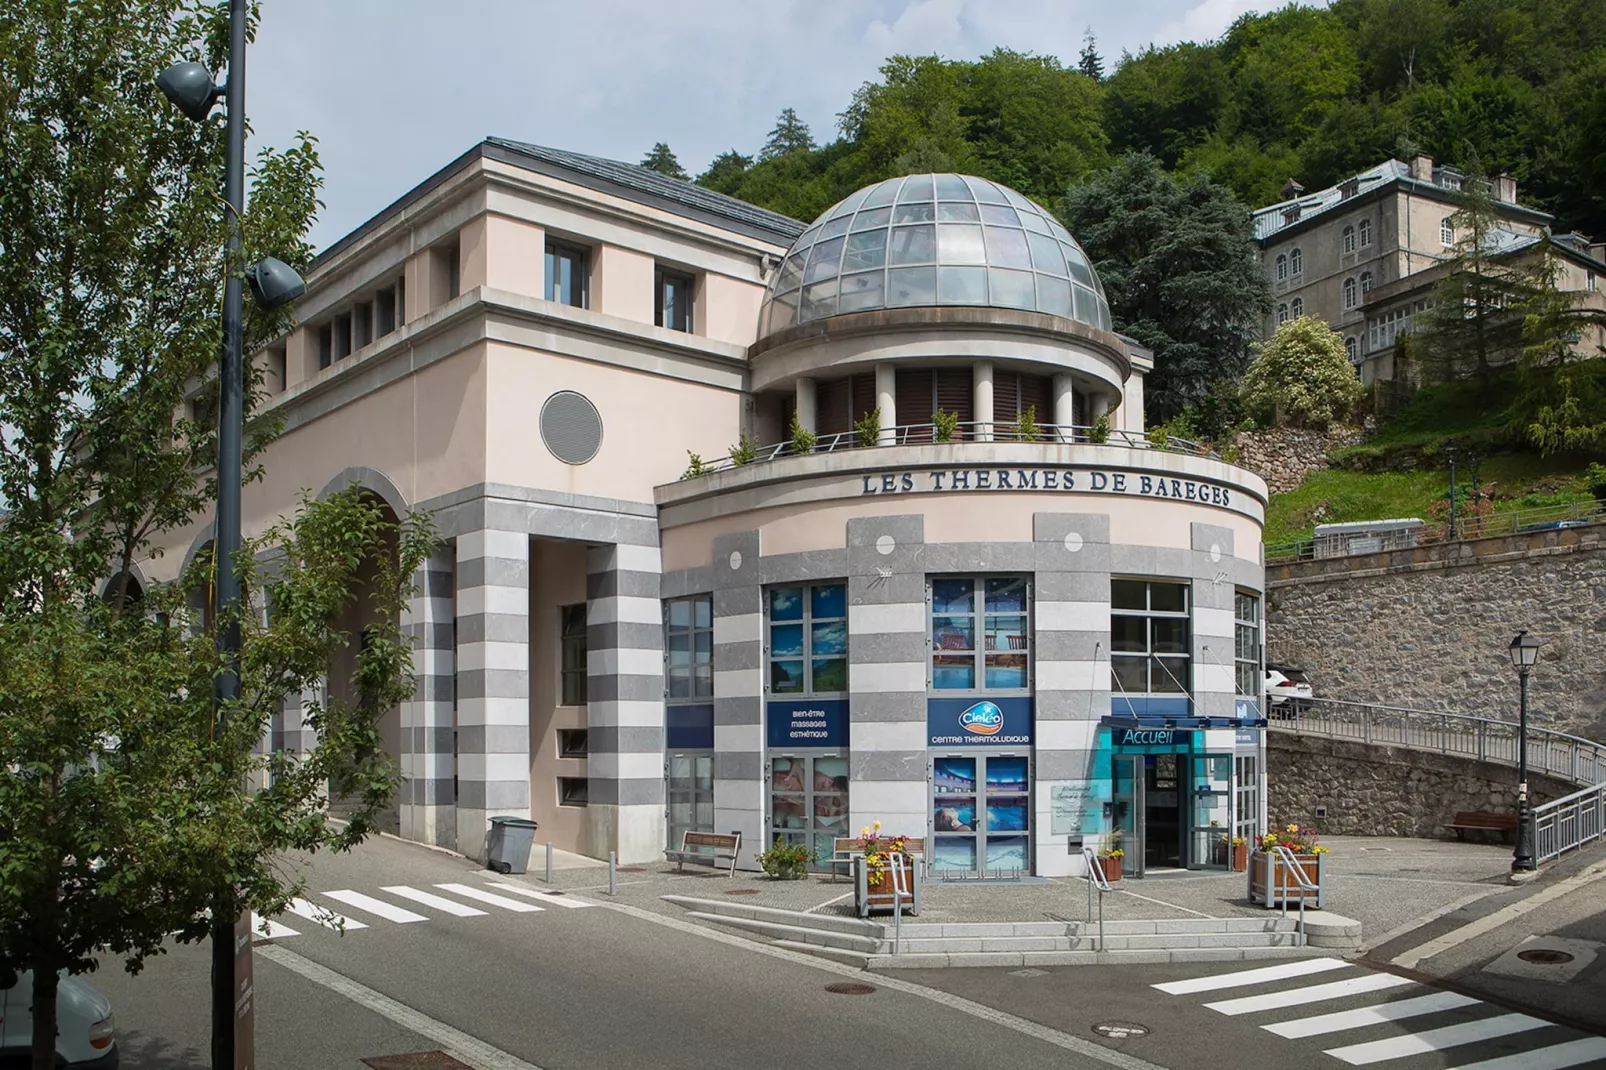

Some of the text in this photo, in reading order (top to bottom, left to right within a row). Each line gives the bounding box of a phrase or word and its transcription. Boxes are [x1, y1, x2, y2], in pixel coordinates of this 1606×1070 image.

[863, 470, 1230, 506] LES THERMES DE BAREGES
[1122, 728, 1174, 744] Accueil
